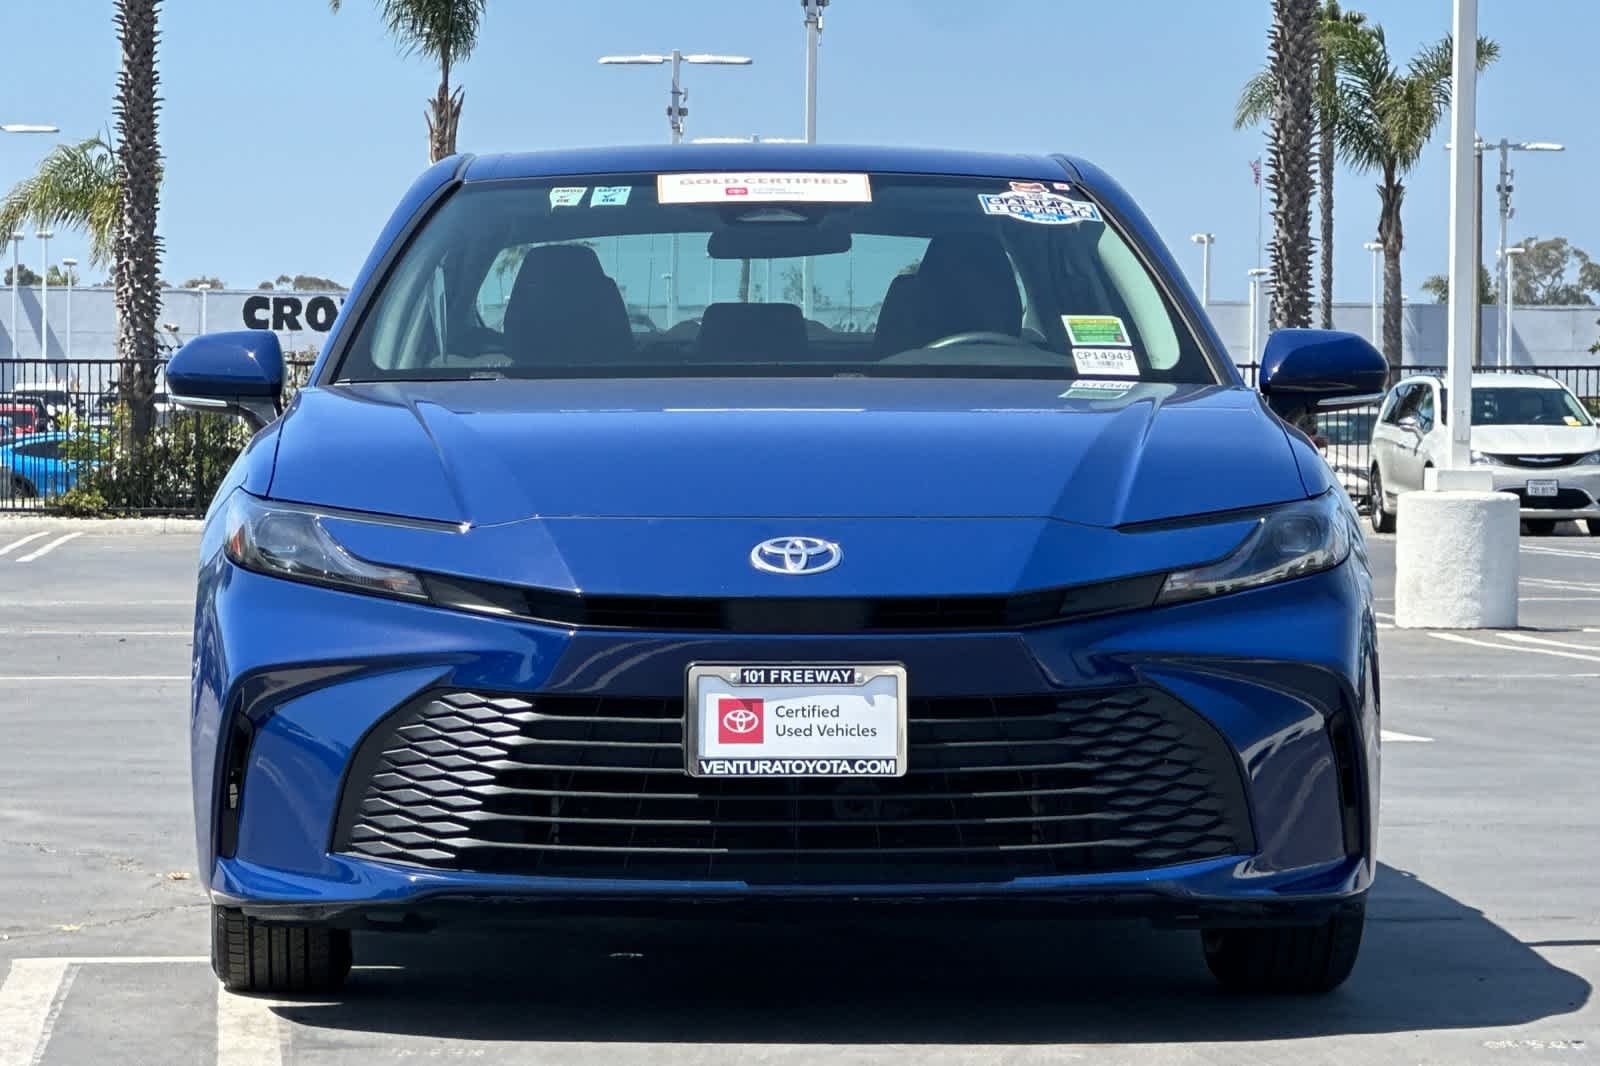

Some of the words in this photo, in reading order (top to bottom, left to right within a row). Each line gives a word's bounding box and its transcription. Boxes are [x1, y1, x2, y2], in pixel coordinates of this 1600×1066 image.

[744, 176, 848, 184] CERTIFIED
[243, 296, 344, 332] CRO
[1076, 351, 1132, 361] CP14949
[743, 669, 765, 683] 101
[770, 669, 851, 683] FREEWAY
[775, 704, 840, 719] Certified
[775, 723, 813, 738] Used
[817, 723, 877, 738] Vehicles
[701, 759, 895, 775] VENTURATOYOTA.COM
